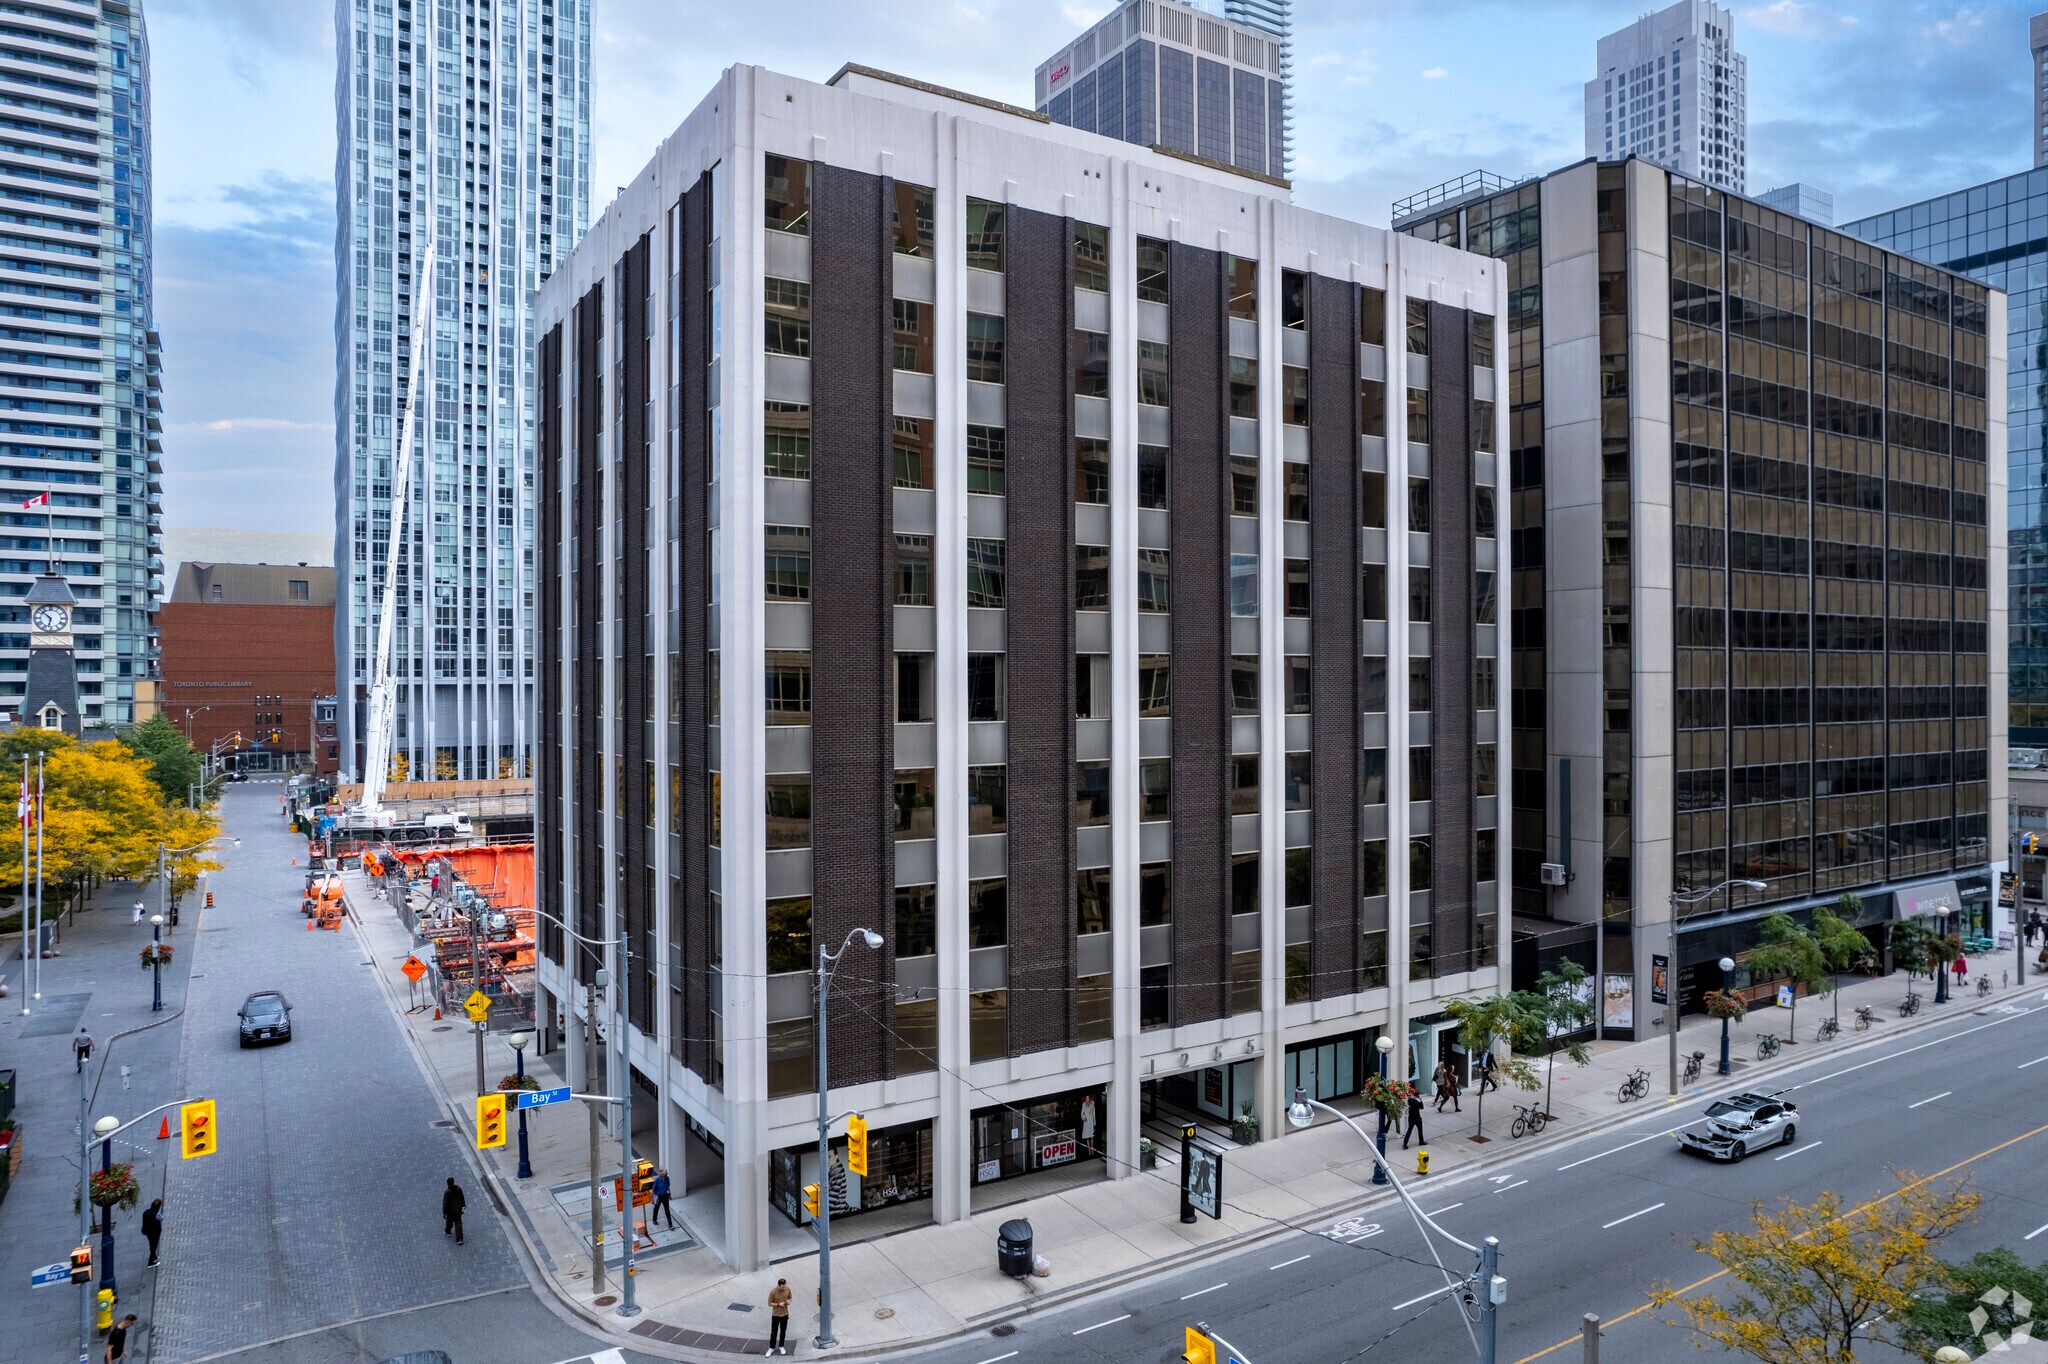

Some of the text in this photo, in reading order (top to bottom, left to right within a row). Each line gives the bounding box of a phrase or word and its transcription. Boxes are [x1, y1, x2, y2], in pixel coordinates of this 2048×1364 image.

[1918, 896, 1935, 912] wine
[1150, 1038, 1255, 1075] 1255
[532, 1093, 550, 1104] Bay
[1043, 1141, 1075, 1160] OPEN
[980, 1168, 994, 1178] HSG
[882, 1186, 898, 1198] HSG
[45, 1273, 58, 1281] Bay
